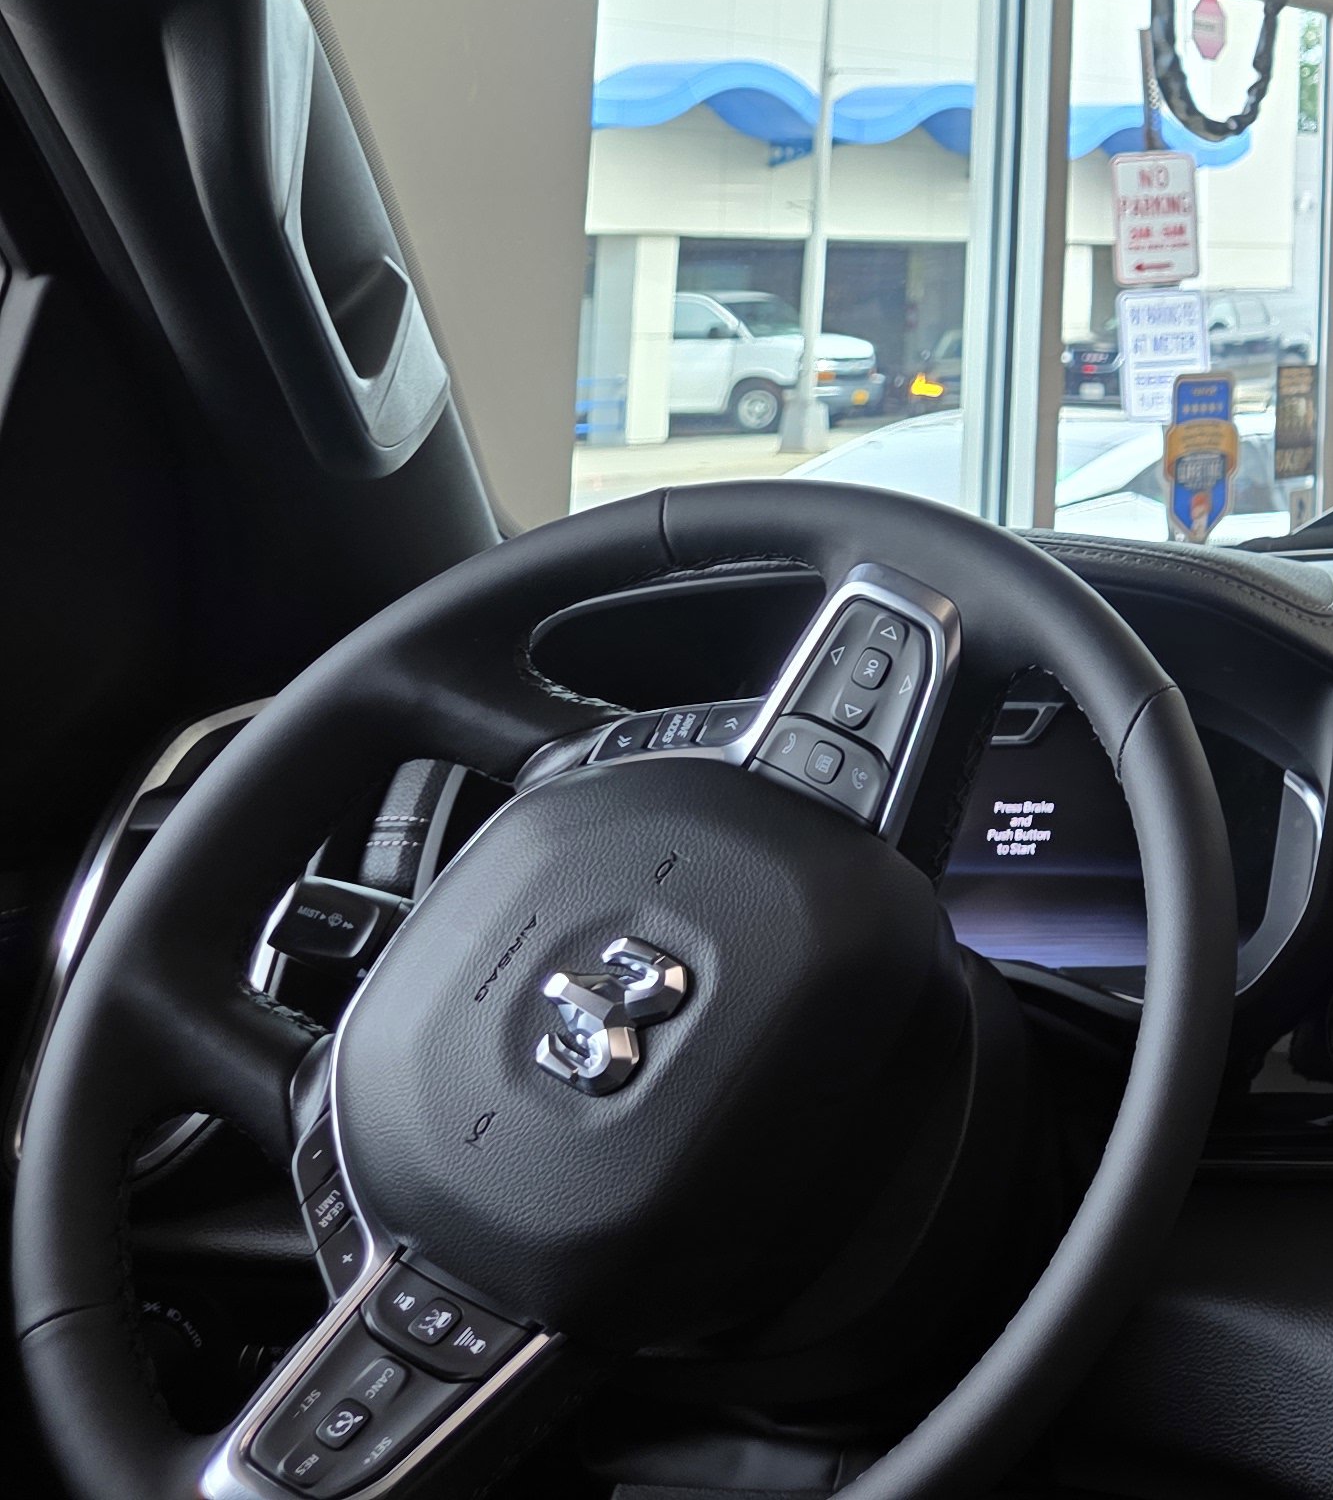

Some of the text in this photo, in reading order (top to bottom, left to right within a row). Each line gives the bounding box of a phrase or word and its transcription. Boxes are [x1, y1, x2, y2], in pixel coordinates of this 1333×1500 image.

[863, 659, 879, 677] OK
[677, 713, 697, 739] DRIVE
[993, 801, 1055, 814] Press Brake
[1010, 814, 1033, 828] and
[986, 828, 1052, 842] Push Button
[996, 842, 1037, 856] to Start
[296, 905, 321, 921] MIST
[474, 914, 538, 1003] AIRBAG
[314, 1189, 341, 1217] LIMIT
[318, 1201, 345, 1228] GEAR
[364, 1367, 395, 1399] CANC
[294, 1454, 320, 1476] RES
